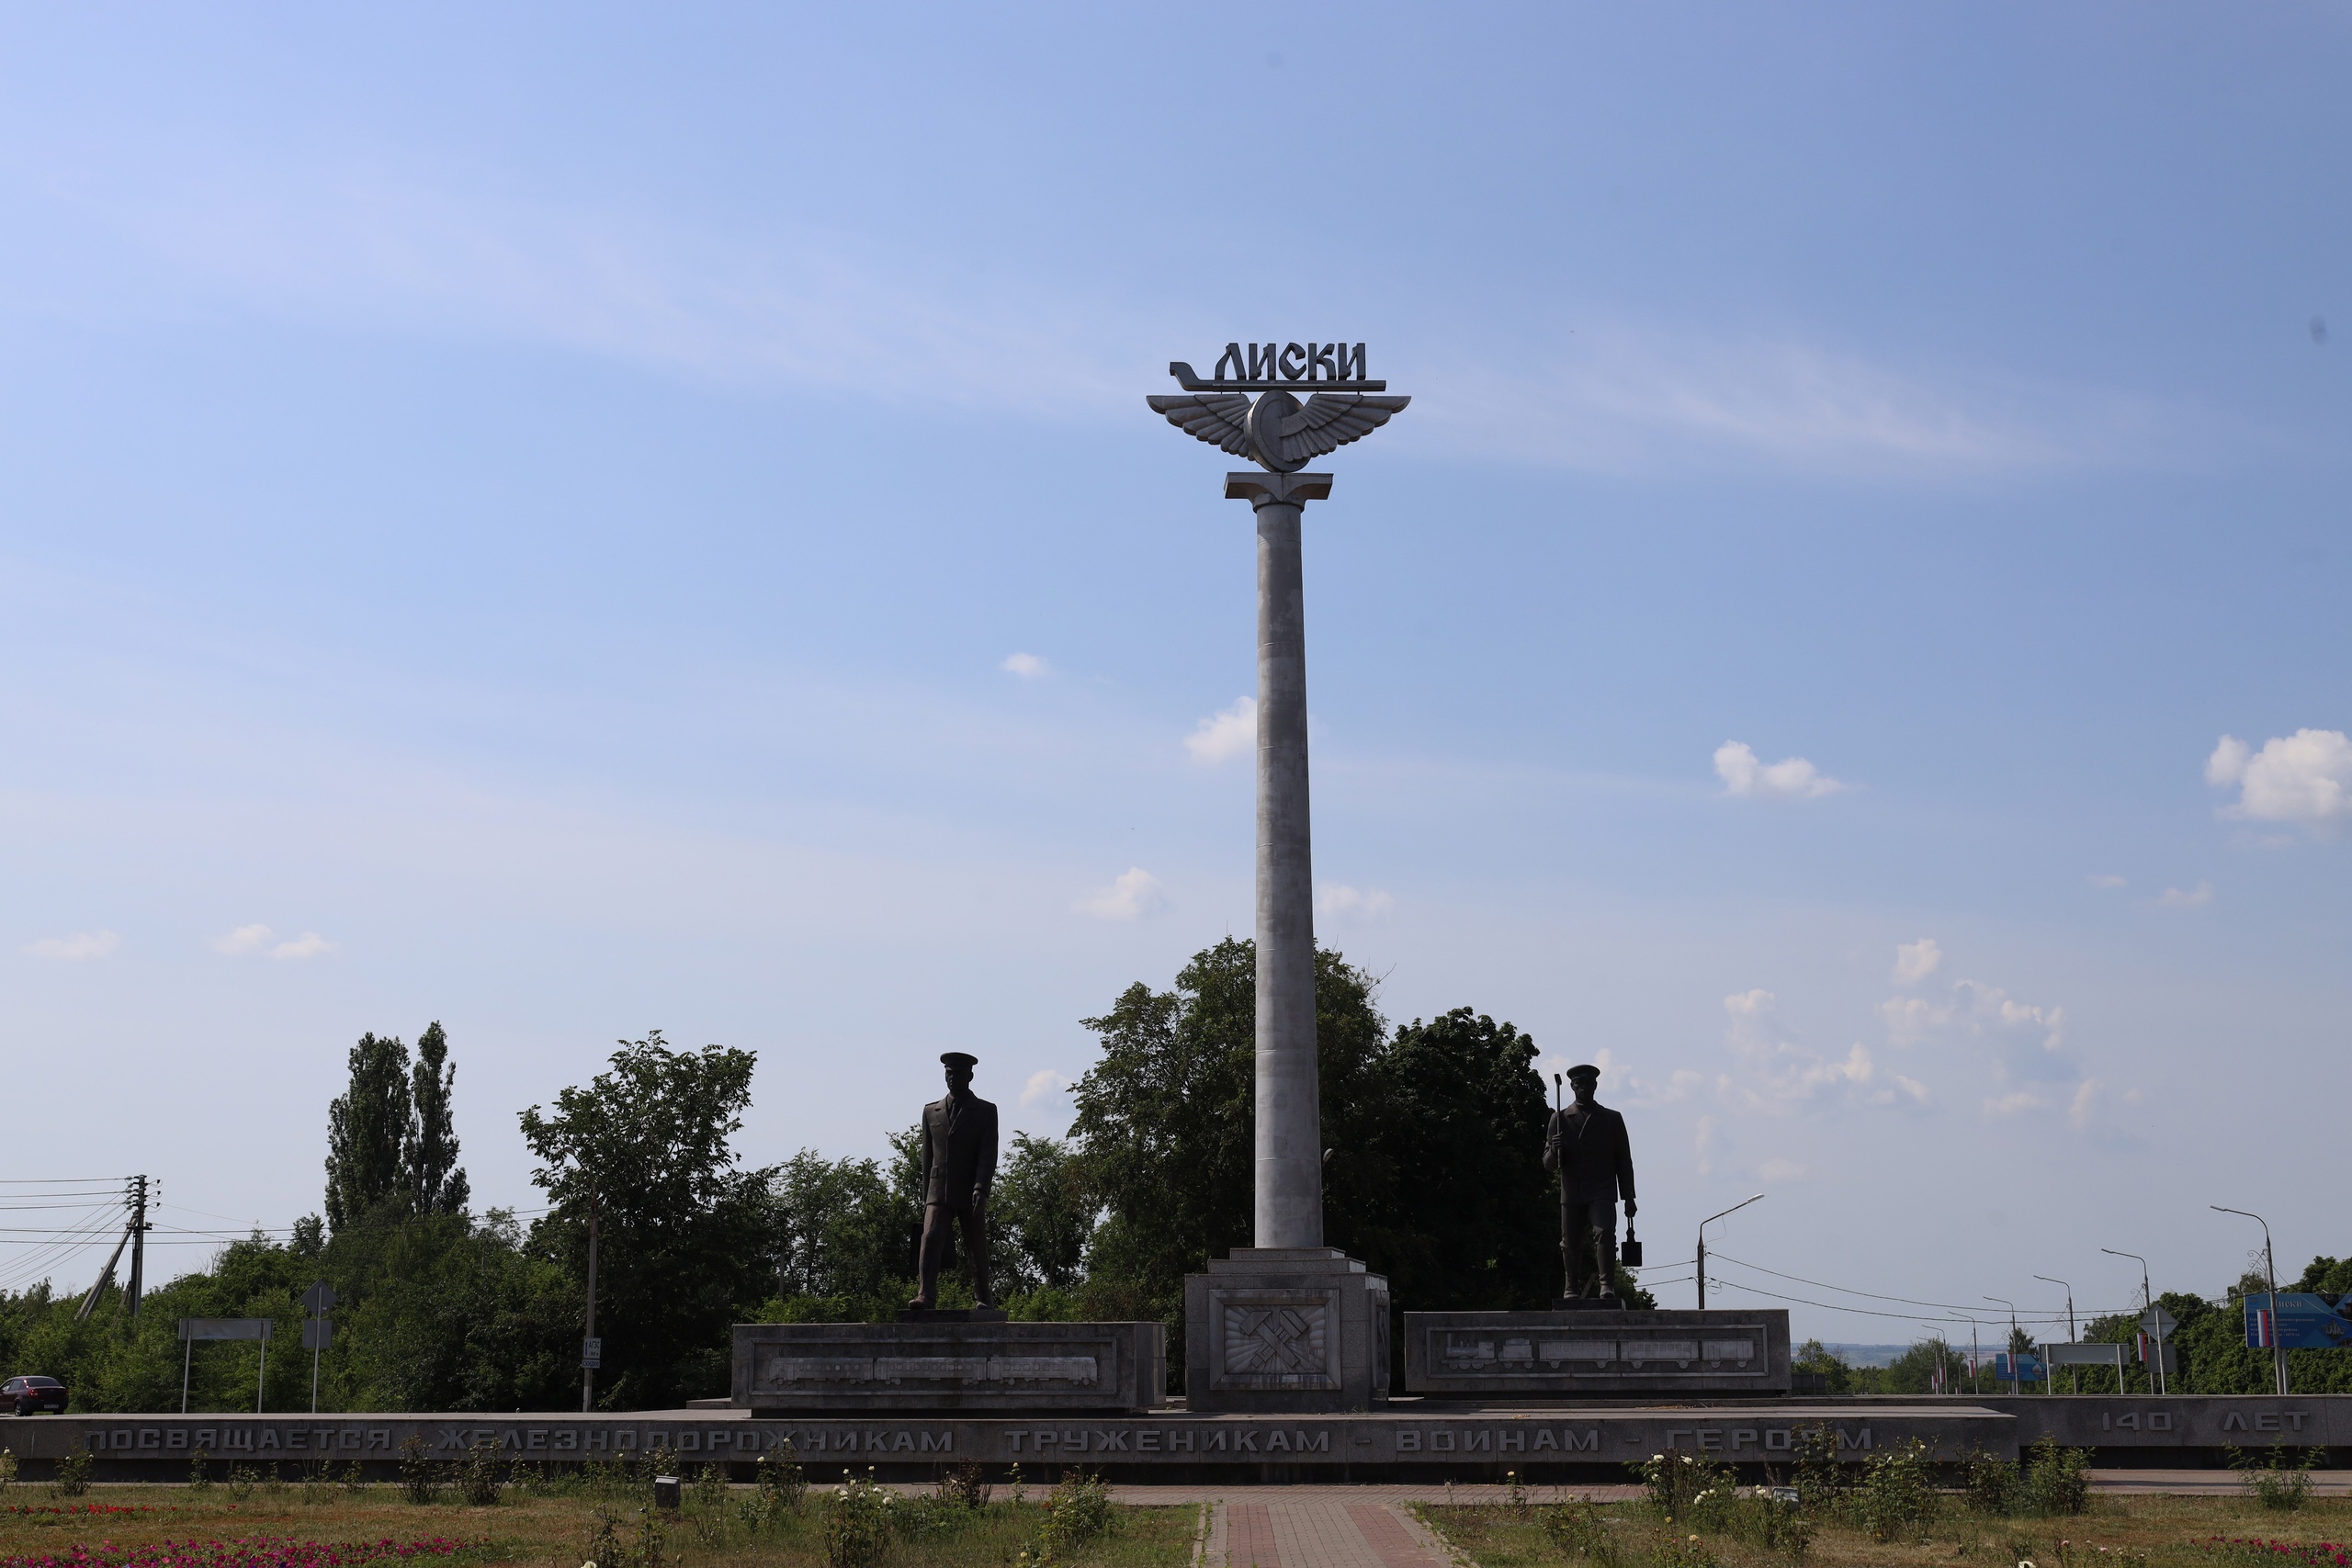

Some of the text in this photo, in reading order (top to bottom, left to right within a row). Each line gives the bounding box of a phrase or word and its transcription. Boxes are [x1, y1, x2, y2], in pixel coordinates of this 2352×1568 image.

[2223, 1411, 2309, 1431] ЛЕТ
[84, 1428, 391, 1452] ПОСВЯЩАЕТСЯ
[436, 1429, 953, 1453] ЖЕЛЕЗНОДОРОЖНИКАМ
[1004, 1430, 1329, 1452] ТРУЖЕНИКАМ
[1396, 1428, 1600, 1452] ВОИНАМ
